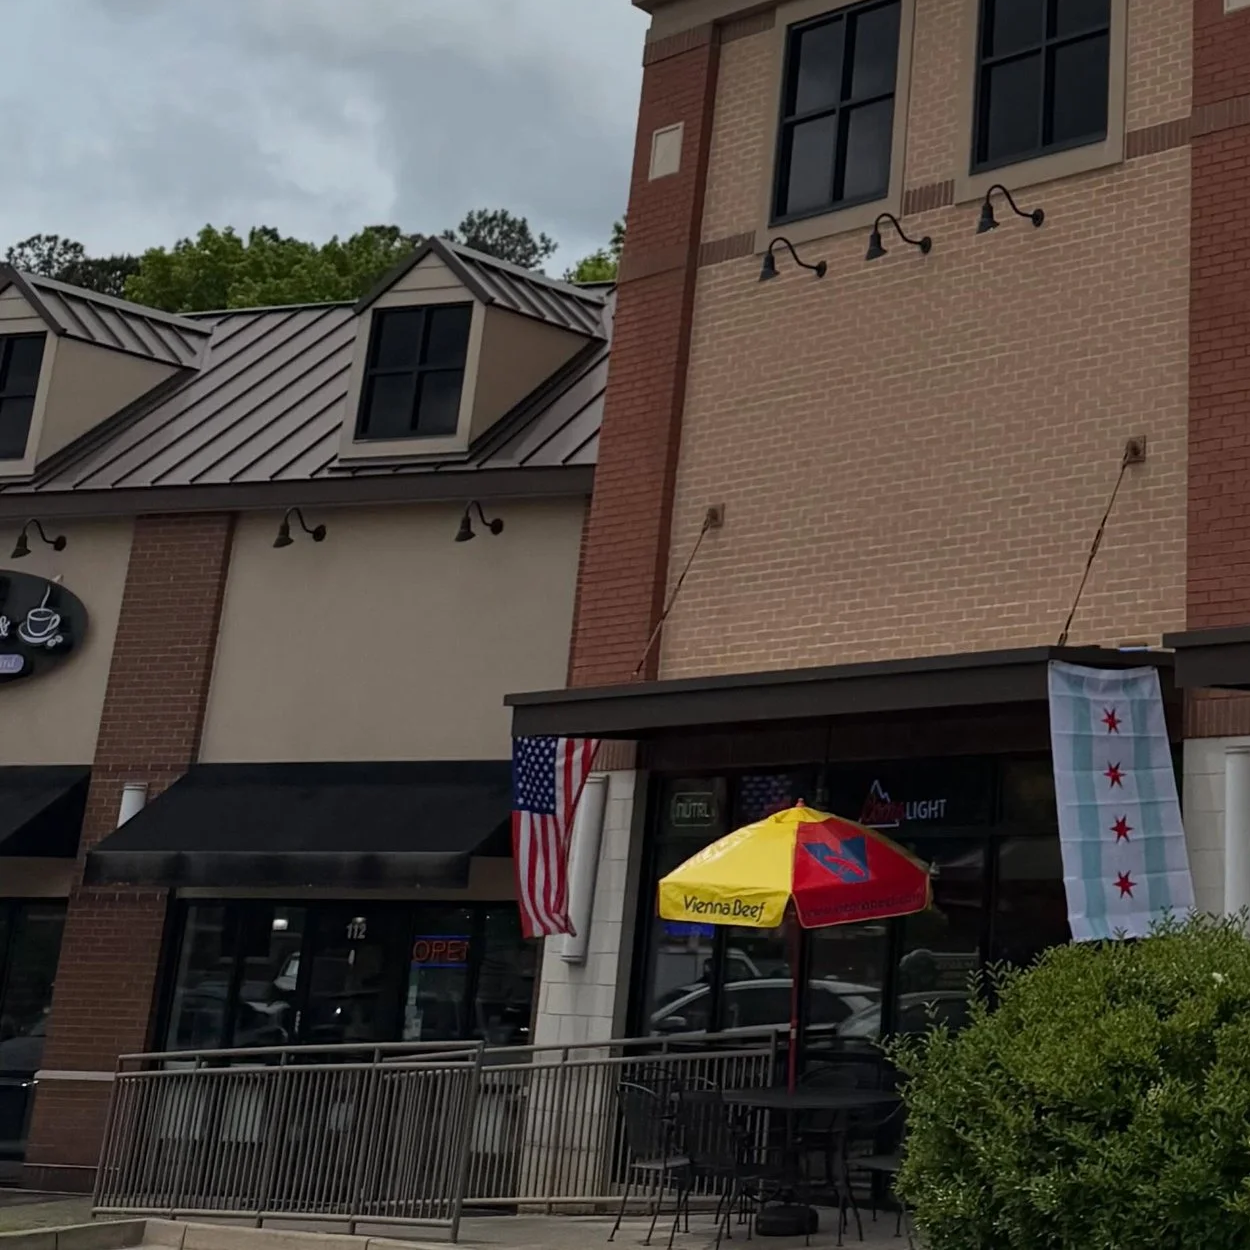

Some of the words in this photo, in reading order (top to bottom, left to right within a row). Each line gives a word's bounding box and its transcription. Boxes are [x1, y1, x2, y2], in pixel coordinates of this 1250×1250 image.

[905, 799, 948, 820] LIGHT
[683, 895, 731, 916] Vienna
[732, 897, 767, 923] Beef
[345, 922, 368, 940] 112
